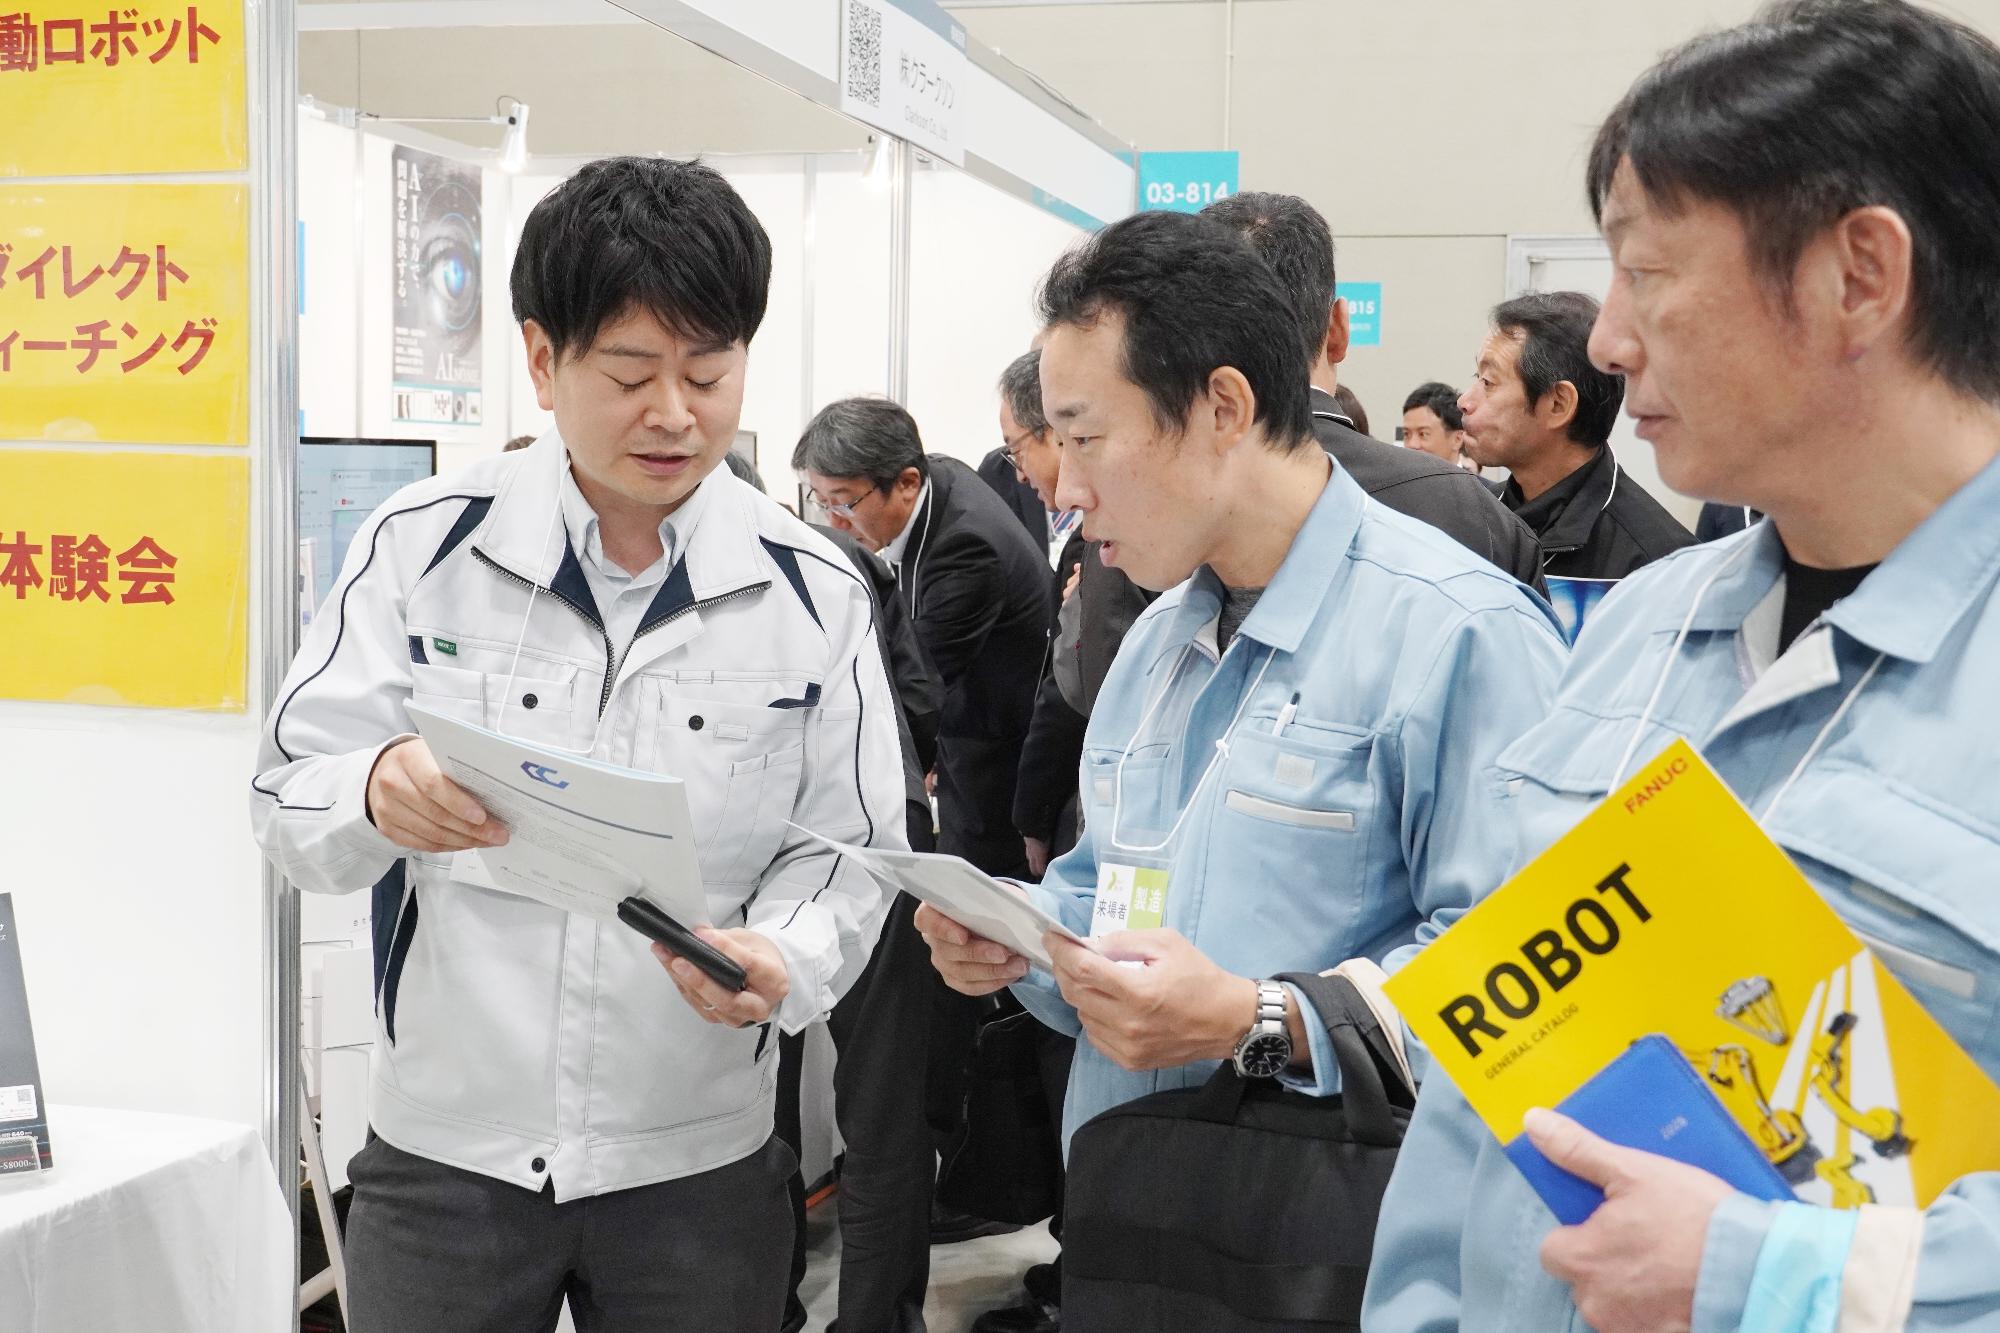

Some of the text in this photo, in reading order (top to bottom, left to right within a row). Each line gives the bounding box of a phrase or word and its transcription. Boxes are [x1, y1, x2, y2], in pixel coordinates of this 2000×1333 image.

[0, 6, 221, 72] 動ロボット
[1146, 182, 1229, 203] 03-814
[0, 531, 178, 606] 体験会
[1624, 757, 1690, 816] FANUC
[1096, 898, 1128, 921] 来場者
[1437, 862, 1653, 1059] ROBOT
[1484, 1002, 1580, 1081] GENERAL CATALOG
